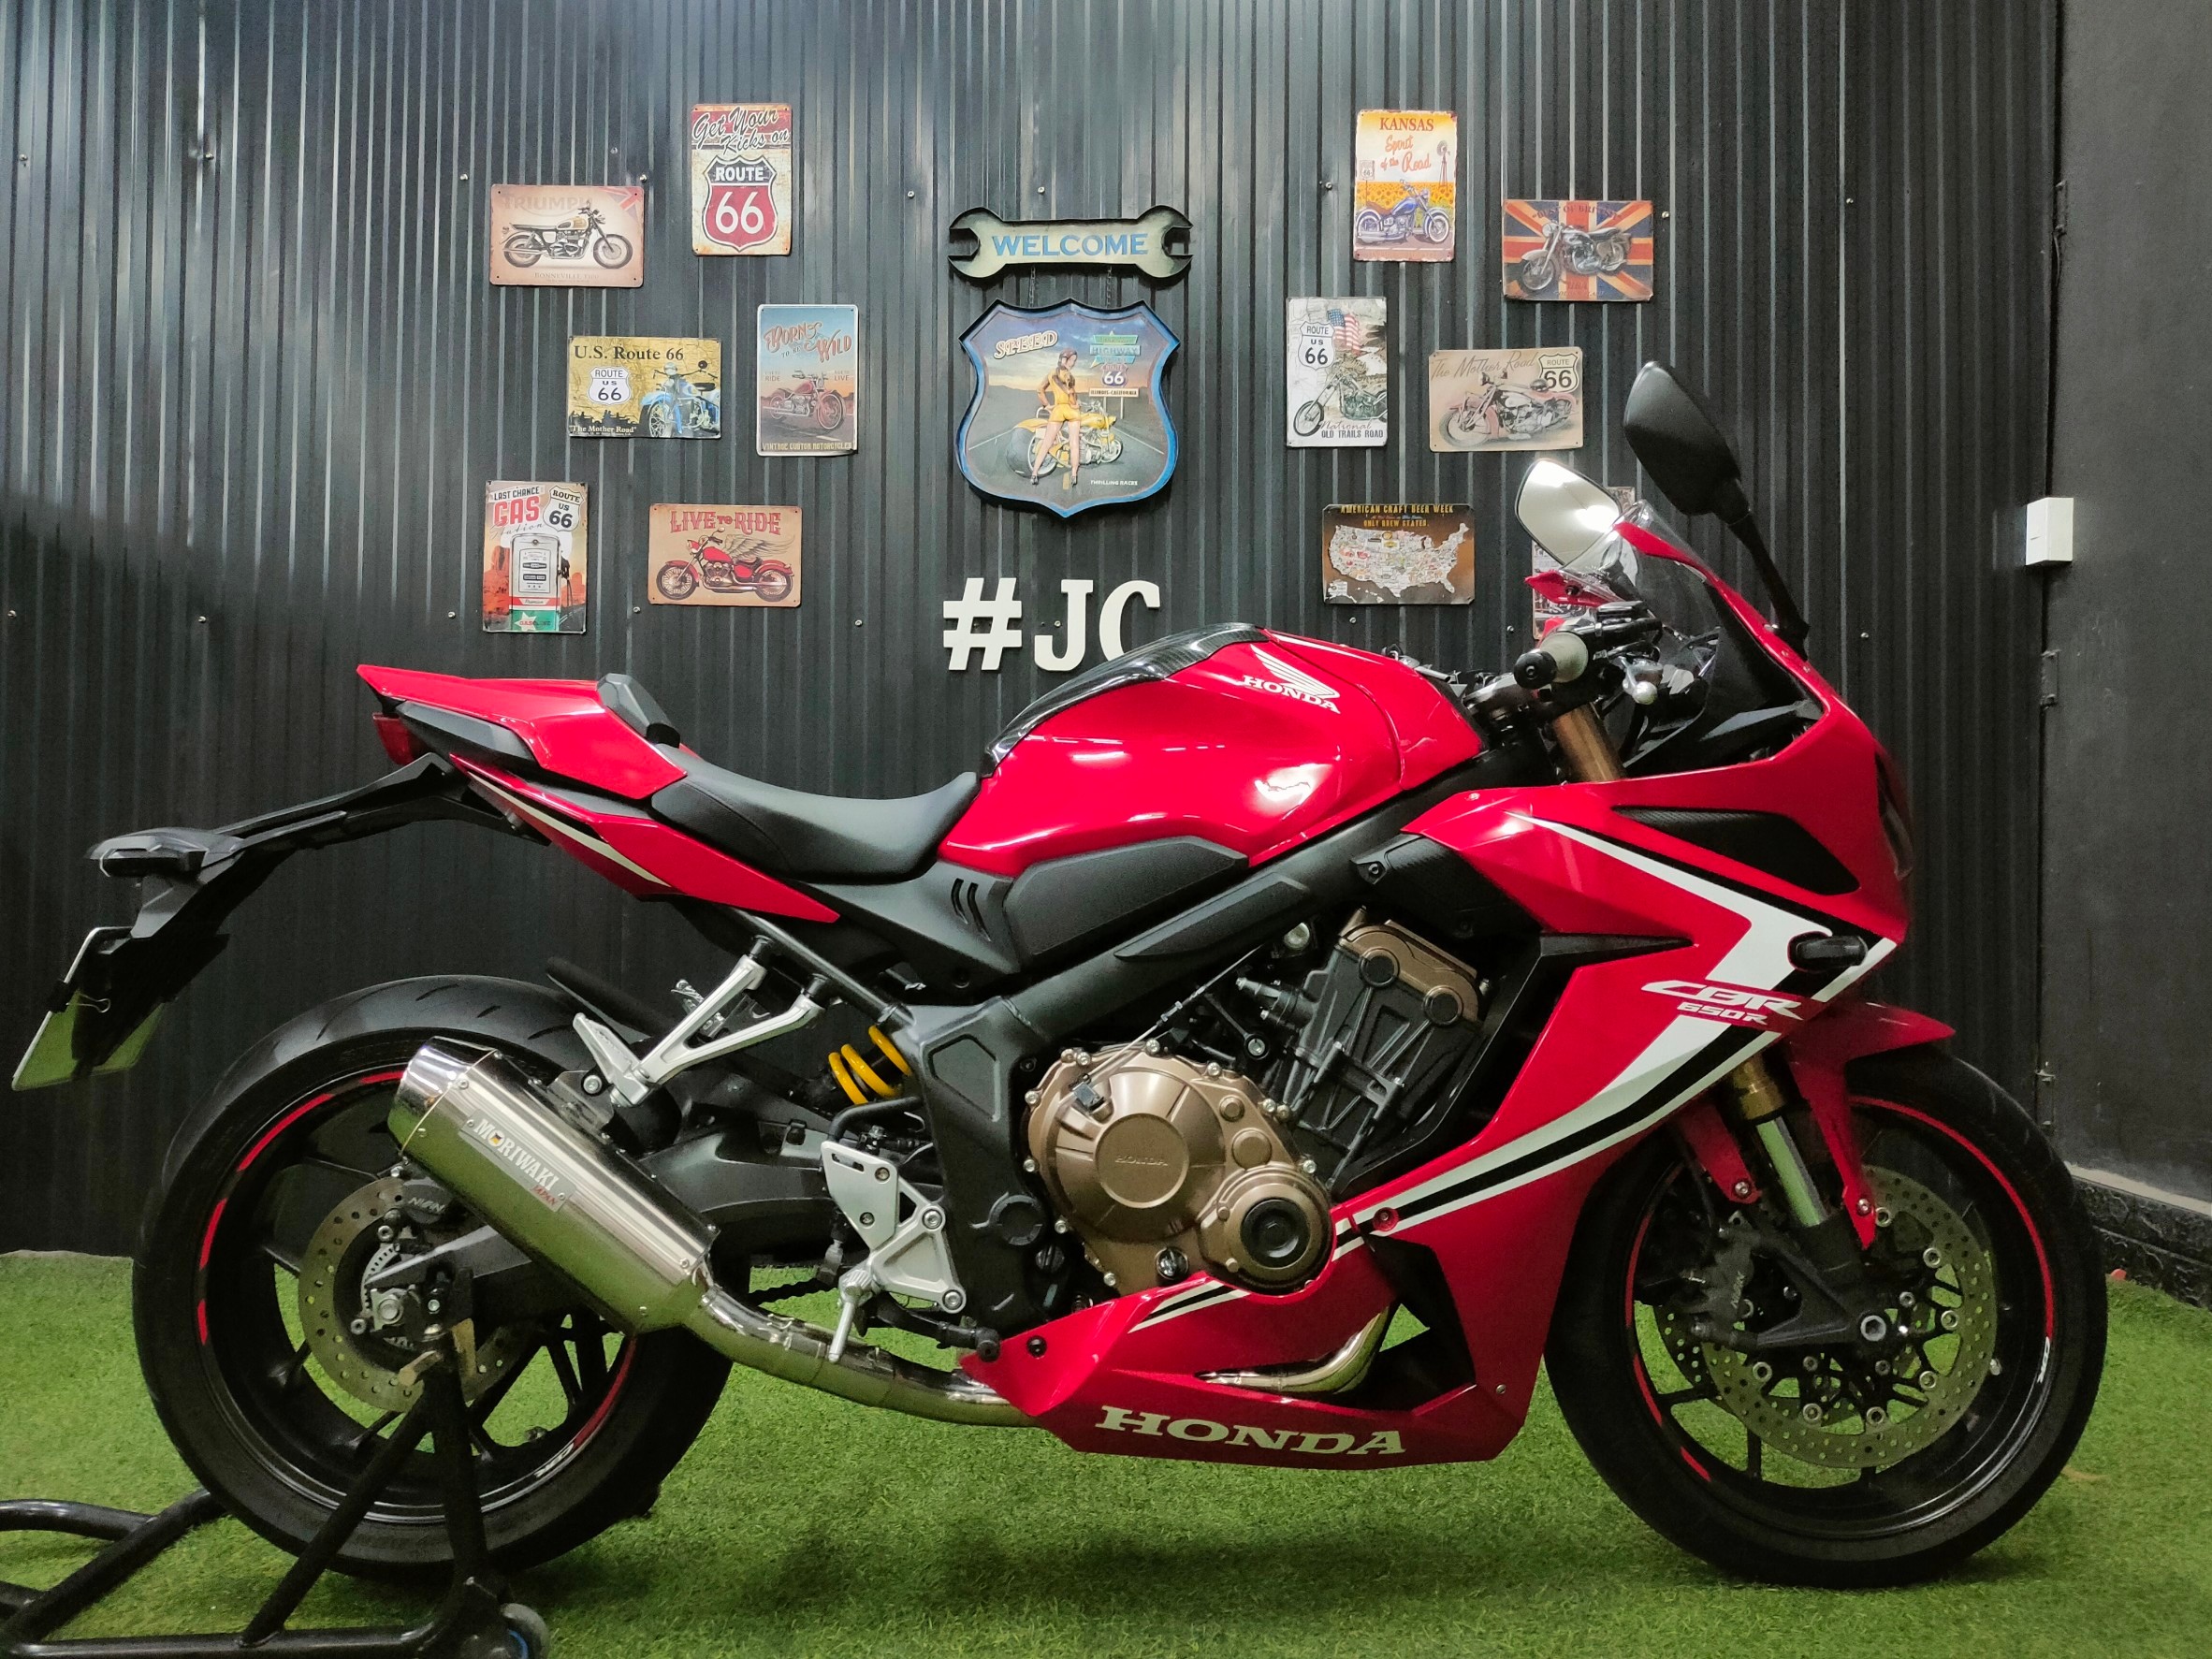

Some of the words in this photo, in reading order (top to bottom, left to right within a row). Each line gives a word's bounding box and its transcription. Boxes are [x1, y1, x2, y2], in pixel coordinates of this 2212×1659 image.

[693, 113, 726, 150] Get
[729, 107, 779, 136] Your
[1379, 118, 1434, 132] KANSAS
[720, 128, 766, 155] Kicks
[771, 130, 789, 144] on
[1385, 135, 1414, 155] Spirit
[1380, 157, 1388, 171] of
[1402, 152, 1432, 173] Road
[715, 167, 764, 182] ROUTE
[502, 196, 593, 211] TRIUMPH
[715, 191, 764, 235] 66
[992, 234, 1149, 256] WELCOME
[764, 321, 822, 353] BORN
[1306, 326, 1329, 335] ROUTE
[575, 346, 607, 358] U.S.
[614, 346, 661, 359] Route
[666, 348, 684, 360] 66
[804, 328, 852, 363] WILD
[994, 330, 1058, 359] SPEED
[1092, 346, 1137, 355] HIGHWAY
[1305, 347, 1328, 365] 66
[1431, 358, 1450, 381] The
[1454, 355, 1500, 377] Mother
[1506, 351, 1538, 371] Road
[1104, 371, 1124, 385] 66
[1544, 370, 1572, 388] 66
[598, 387, 621, 400] 66
[1320, 421, 1372, 430] National
[1321, 429, 1334, 438] OLD
[1338, 429, 1361, 438] TRAILS
[1364, 429, 1384, 438] ROAD
[494, 490, 511, 501] LAST
[512, 486, 540, 498] CHANCE
[552, 489, 581, 503] ROUTE
[493, 496, 540, 527] GAS
[559, 502, 570, 511] US
[1341, 504, 1380, 514] AMERICAN
[1383, 505, 1407, 514] CRAFT
[1411, 505, 1430, 514] BEER
[1433, 504, 1454, 514] WEEK
[548, 510, 573, 529] 66
[670, 511, 716, 533] LIVE
[717, 516, 733, 525] TO
[735, 512, 781, 535] RIDE
[1243, 675, 1341, 714] HONDA
[1641, 980, 1804, 1021] CBR
[1677, 1002, 1768, 1025] 650R
[473, 1118, 560, 1191] MORIWAKI
[1114, 1155, 1169, 1167] HONDA
[531, 1185, 558, 1206] JAPAN
[1095, 1404, 1406, 1455] HONDA
